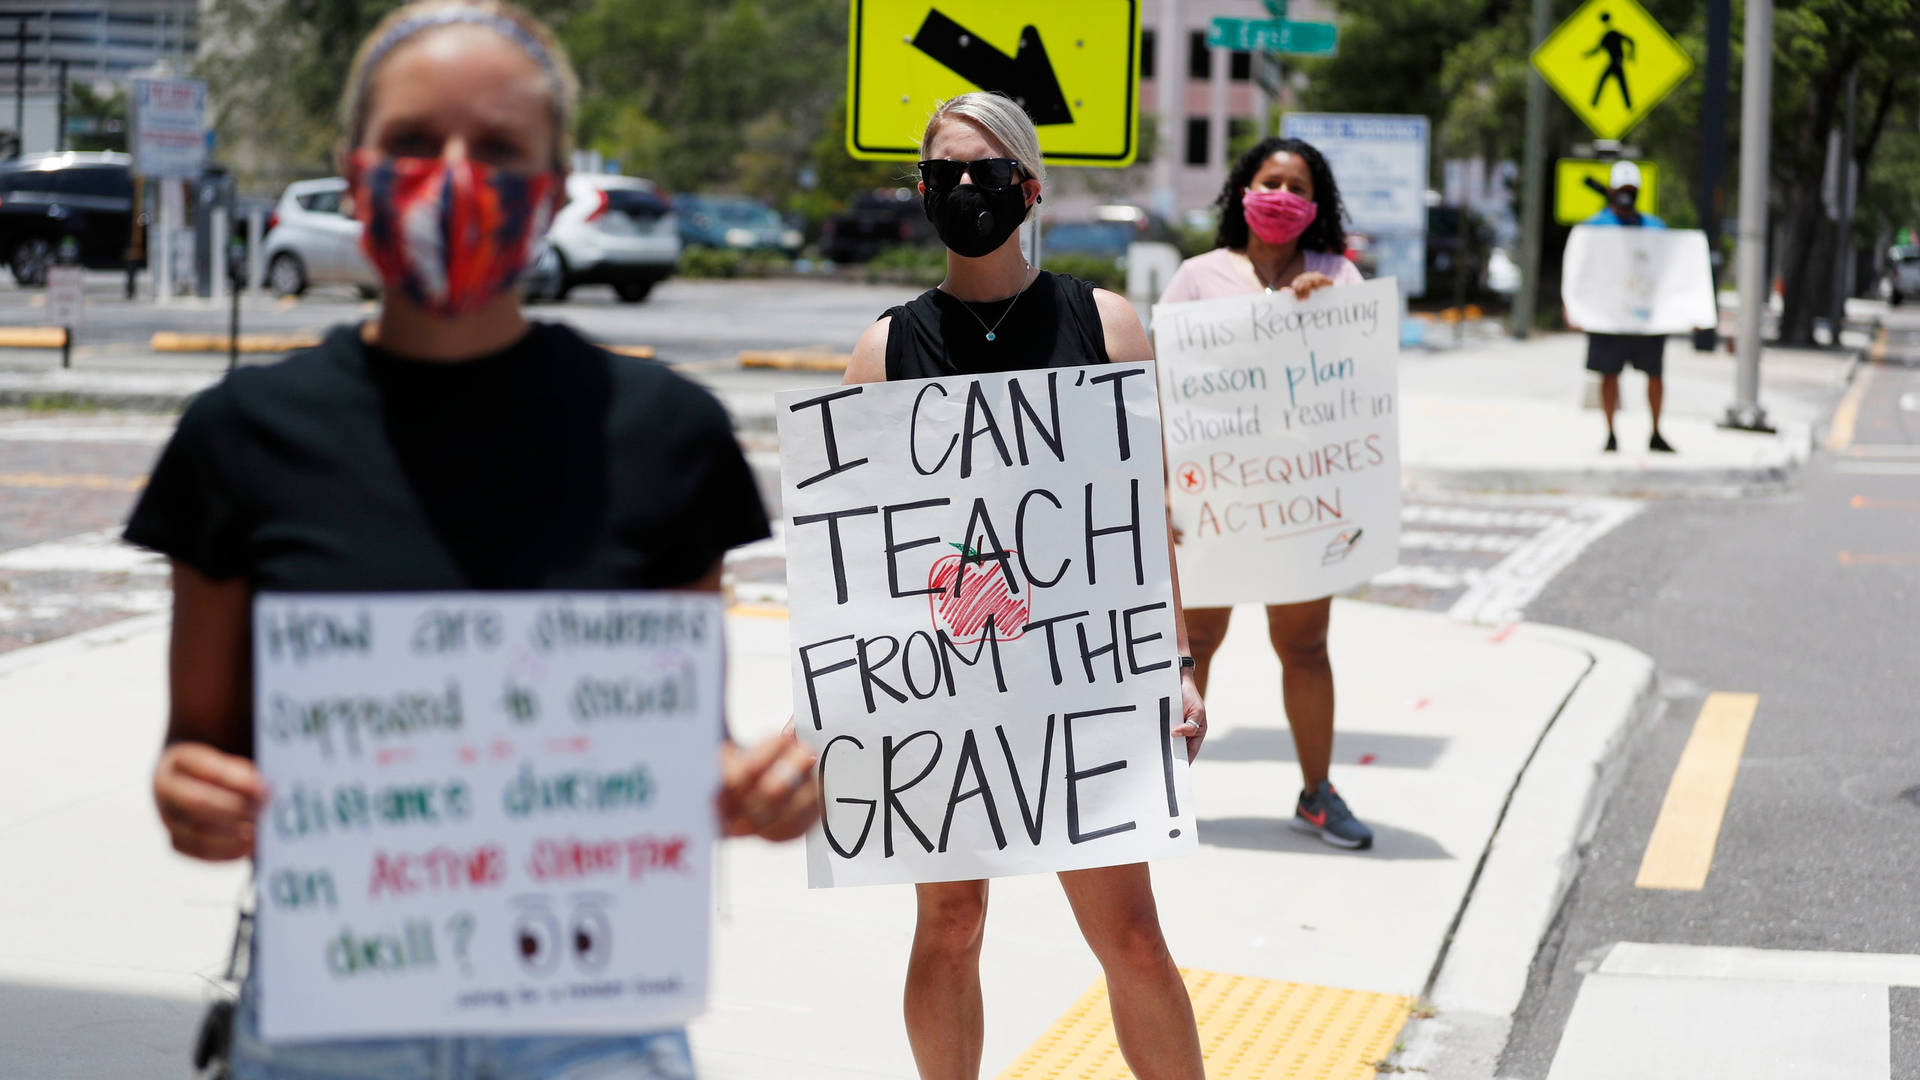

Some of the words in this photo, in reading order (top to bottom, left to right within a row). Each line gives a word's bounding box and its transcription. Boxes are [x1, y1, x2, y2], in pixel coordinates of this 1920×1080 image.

[1171, 312, 1235, 352] This
[1250, 299, 1379, 347] Reopening
[1168, 364, 1266, 405] lesson
[1286, 350, 1354, 405] plan
[790, 386, 868, 488] I
[910, 368, 1146, 479] CAN'T
[1170, 402, 1262, 443] should
[1284, 389, 1365, 431] result
[1371, 391, 1392, 418] in
[1209, 433, 1384, 490] REQUIRES
[1197, 486, 1343, 537] ACTION
[793, 479, 1145, 605] TEACH
[798, 613, 1008, 731] FROM
[1021, 601, 1172, 686] THE
[817, 695, 1180, 859] GRAVE!
